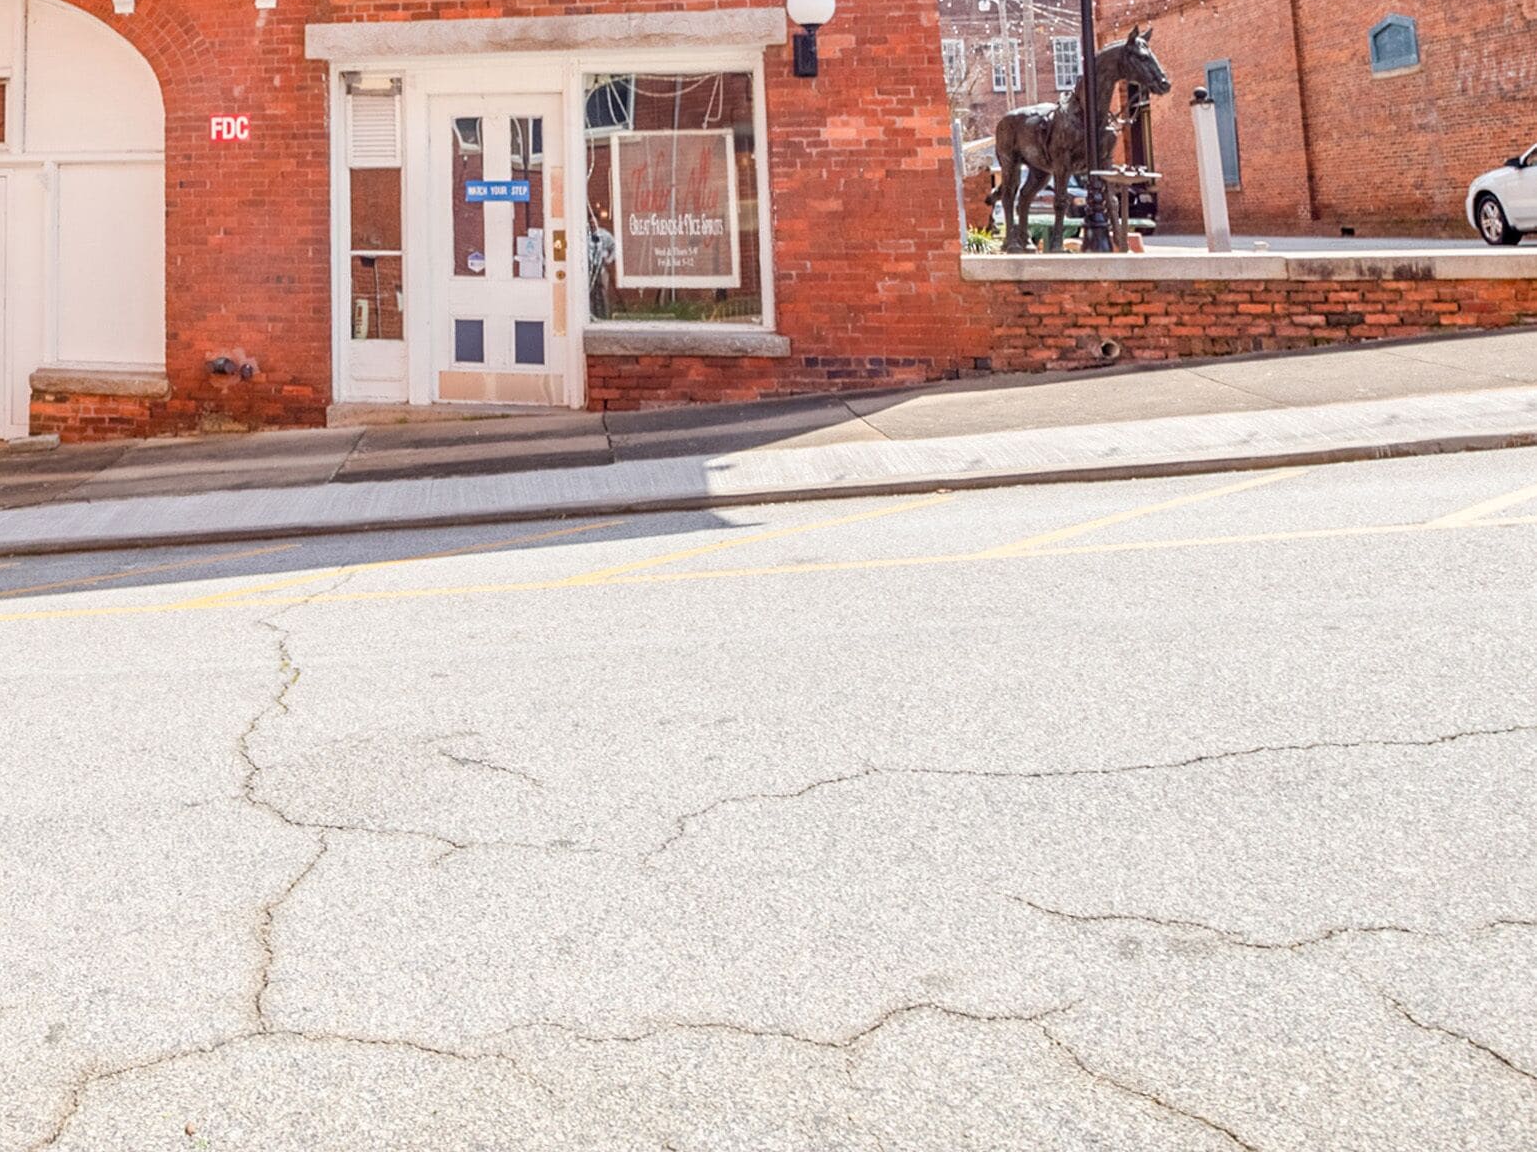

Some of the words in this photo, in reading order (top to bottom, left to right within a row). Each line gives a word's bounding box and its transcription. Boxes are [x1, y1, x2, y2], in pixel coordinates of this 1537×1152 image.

[211, 116, 249, 140] FDC
[467, 185, 488, 196] WATCH
[490, 185, 508, 196] YOUR
[511, 185, 528, 196] STEP
